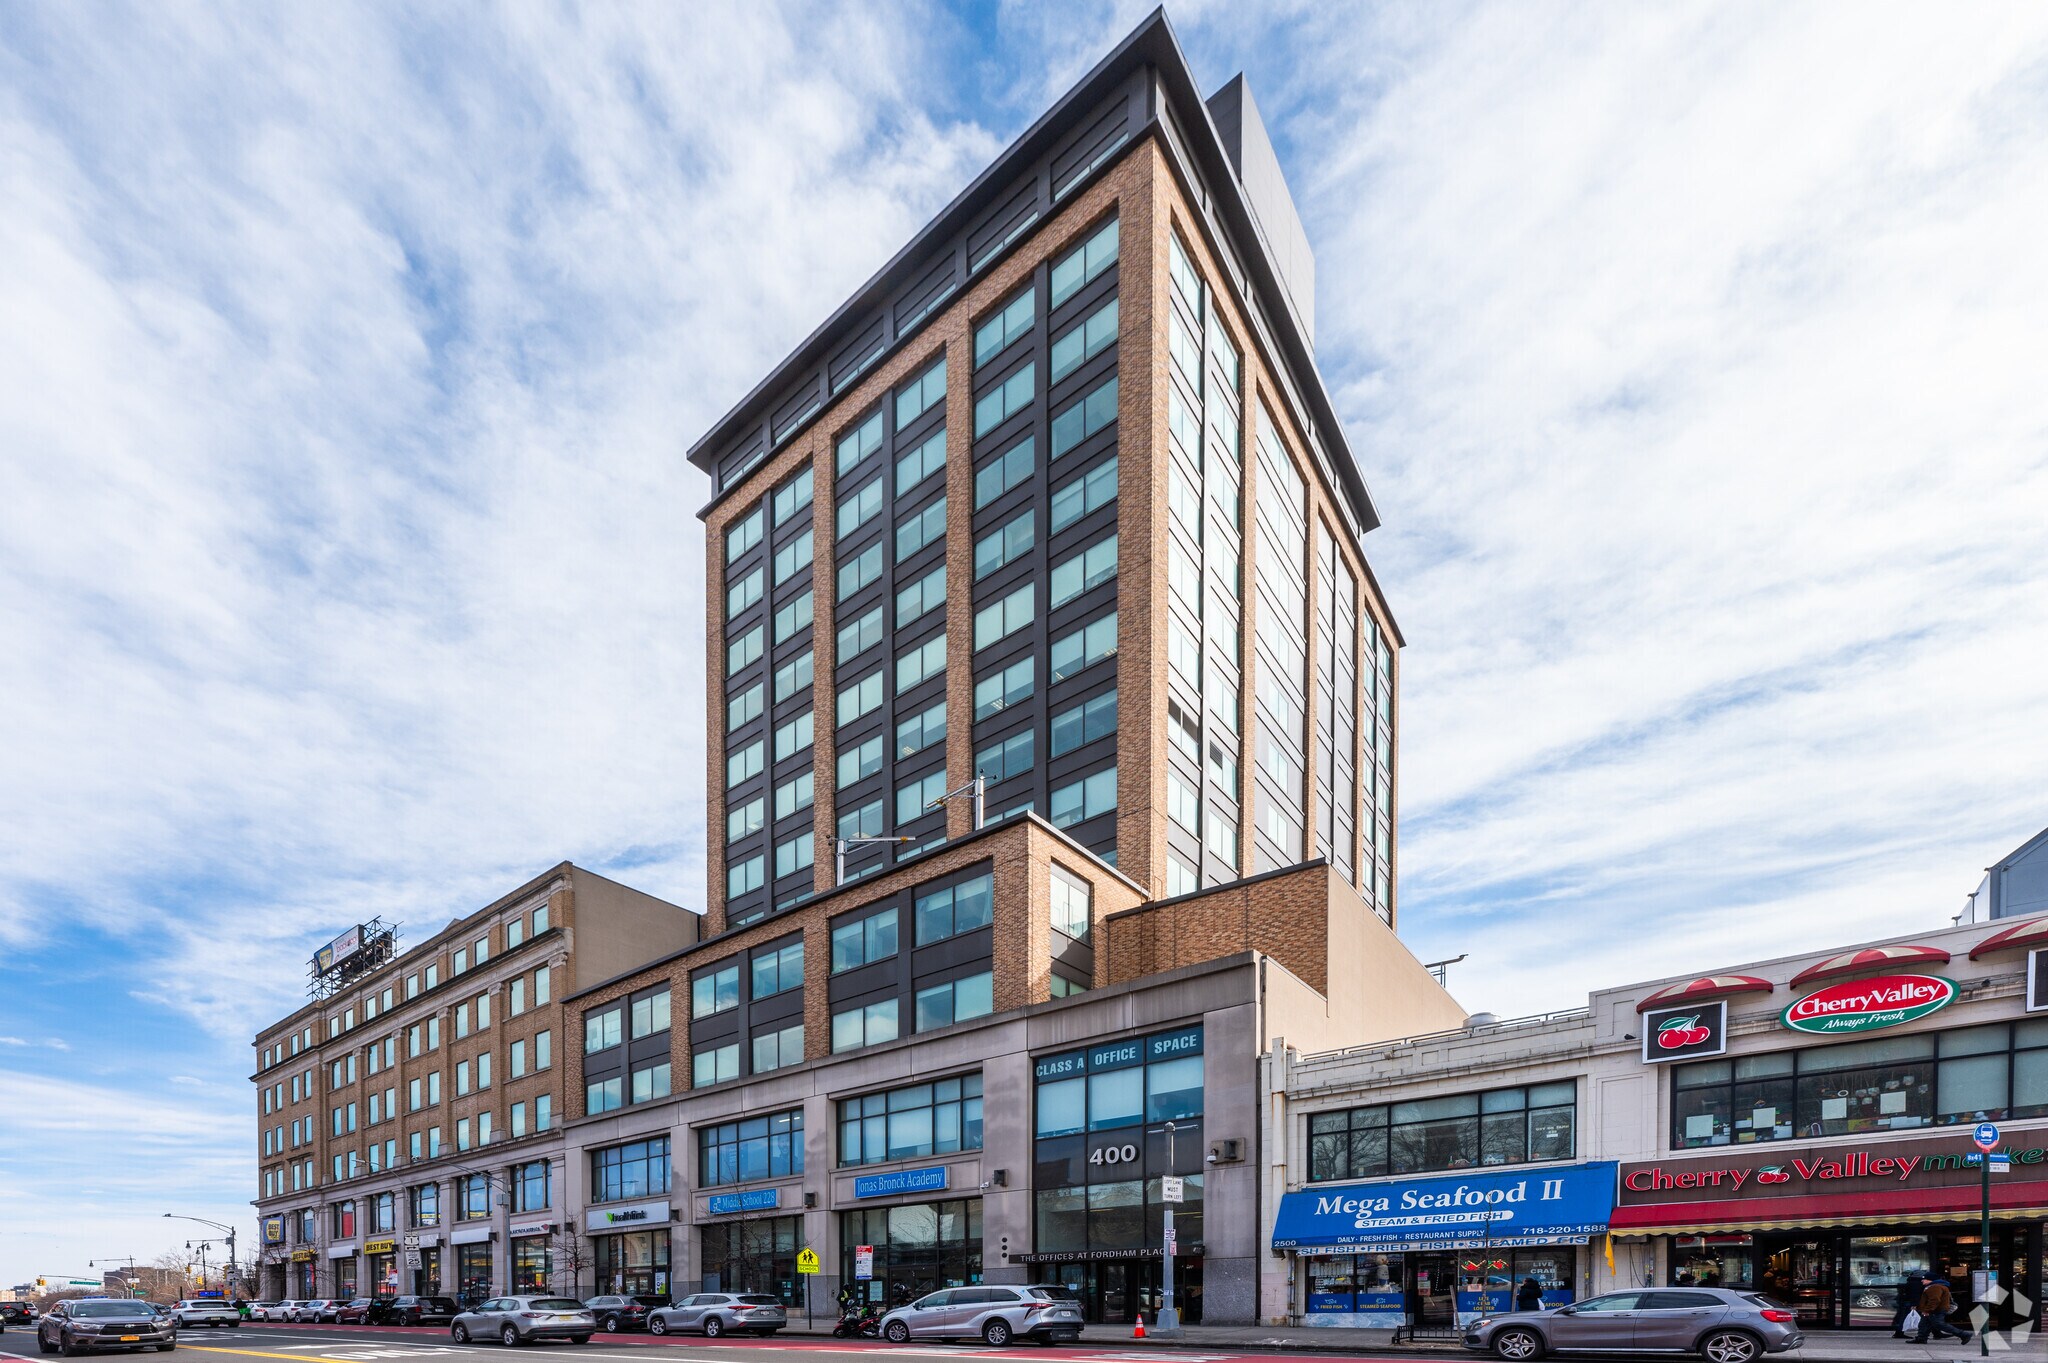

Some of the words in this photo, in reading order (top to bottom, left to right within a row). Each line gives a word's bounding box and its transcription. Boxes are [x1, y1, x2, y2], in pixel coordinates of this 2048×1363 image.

[1822, 1016, 1866, 1030] Always
[1868, 1010, 1905, 1024] Fresh
[1036, 1059, 1073, 1077] CLASS
[1077, 1057, 1085, 1070] A
[1095, 1046, 1137, 1066] OFFICE
[1154, 1034, 1197, 1054] SPACE
[1089, 1144, 1136, 1166] 400
[1625, 1168, 1752, 1191] Cherry
[1791, 1151, 1921, 1181] Valley
[1923, 1146, 2044, 1171] make
[857, 1179, 878, 1196] Jonas
[879, 1174, 905, 1191] Bronck
[907, 1171, 944, 1188] Academy
[722, 1195, 742, 1209] Middle
[743, 1193, 763, 1207] School
[763, 1191, 775, 1204] 228
[1314, 1195, 1390, 1219] Mega
[1400, 1181, 1526, 1210] Seafood
[1540, 1179, 1564, 1201] II
[1362, 1218, 1406, 1228] STEAM
[1410, 1216, 1421, 1225] &
[1424, 1214, 1466, 1223] FRIED
[1469, 1211, 1503, 1221] FISH
[1337, 1236, 1354, 1244] DAILY
[1360, 1235, 1382, 1243] FRESH
[1382, 1234, 1398, 1242] FISH
[1405, 1232, 1455, 1240] RESTAURANT
[1457, 1230, 1486, 1238] SUPPLY
[1523, 1224, 1607, 1235] 718-220-1588
[366, 1243, 379, 1251] BEST
[380, 1242, 393, 1250] BUY
[1325, 1246, 1356, 1254] FISH
[1366, 1244, 1410, 1252] FRIED
[1420, 1241, 1454, 1250] FISH
[1469, 1237, 1549, 1248] STEAMED
[1555, 1235, 1587, 1245] FIS
[1020, 1254, 1036, 1262] THE
[1039, 1253, 1074, 1262] OFFICES
[1077, 1252, 1088, 1260] AT
[1091, 1249, 1137, 1259] FORDHAM
[1141, 1247, 1165, 1256] PLAC
